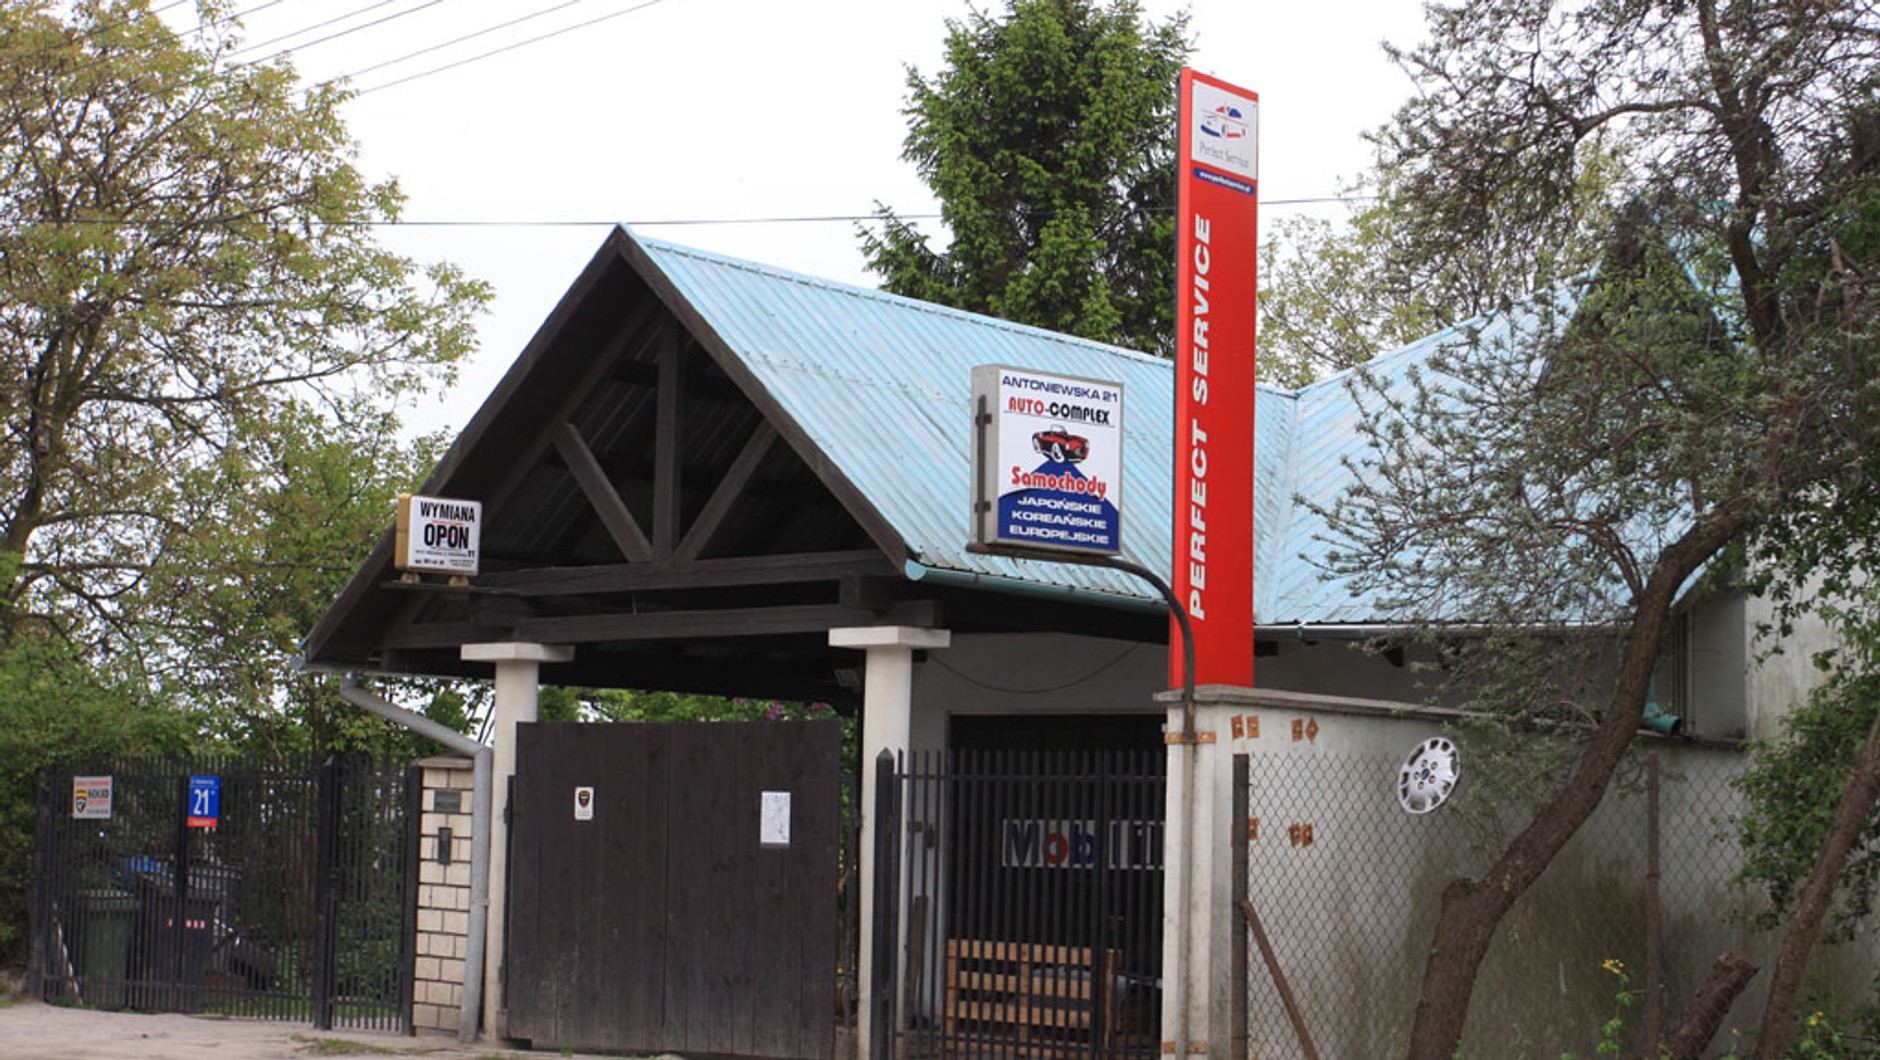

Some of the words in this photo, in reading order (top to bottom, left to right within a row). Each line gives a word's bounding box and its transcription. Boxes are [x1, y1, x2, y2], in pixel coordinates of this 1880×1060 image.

[1199, 141, 1224, 160] Perfect
[1225, 149, 1250, 168] Service
[1192, 214, 1211, 405] SERVICE
[1002, 375, 1101, 401] ANTONIEWSKA
[1102, 391, 1118, 403] 21
[1008, 396, 1110, 425] AUTO-COMPLEX
[1012, 466, 1107, 500] Samochody
[420, 501, 475, 522] WYMIANA
[1017, 496, 1102, 514] JAPOŃSKIE
[1011, 510, 1108, 529] KOREAŃSKIE
[1189, 419, 1209, 620] PERFECT
[424, 523, 469, 549] OPON
[1009, 525, 1110, 545] EUROPEJSKIE
[193, 788, 209, 815] 21
[1005, 823, 1119, 866] Mobl
